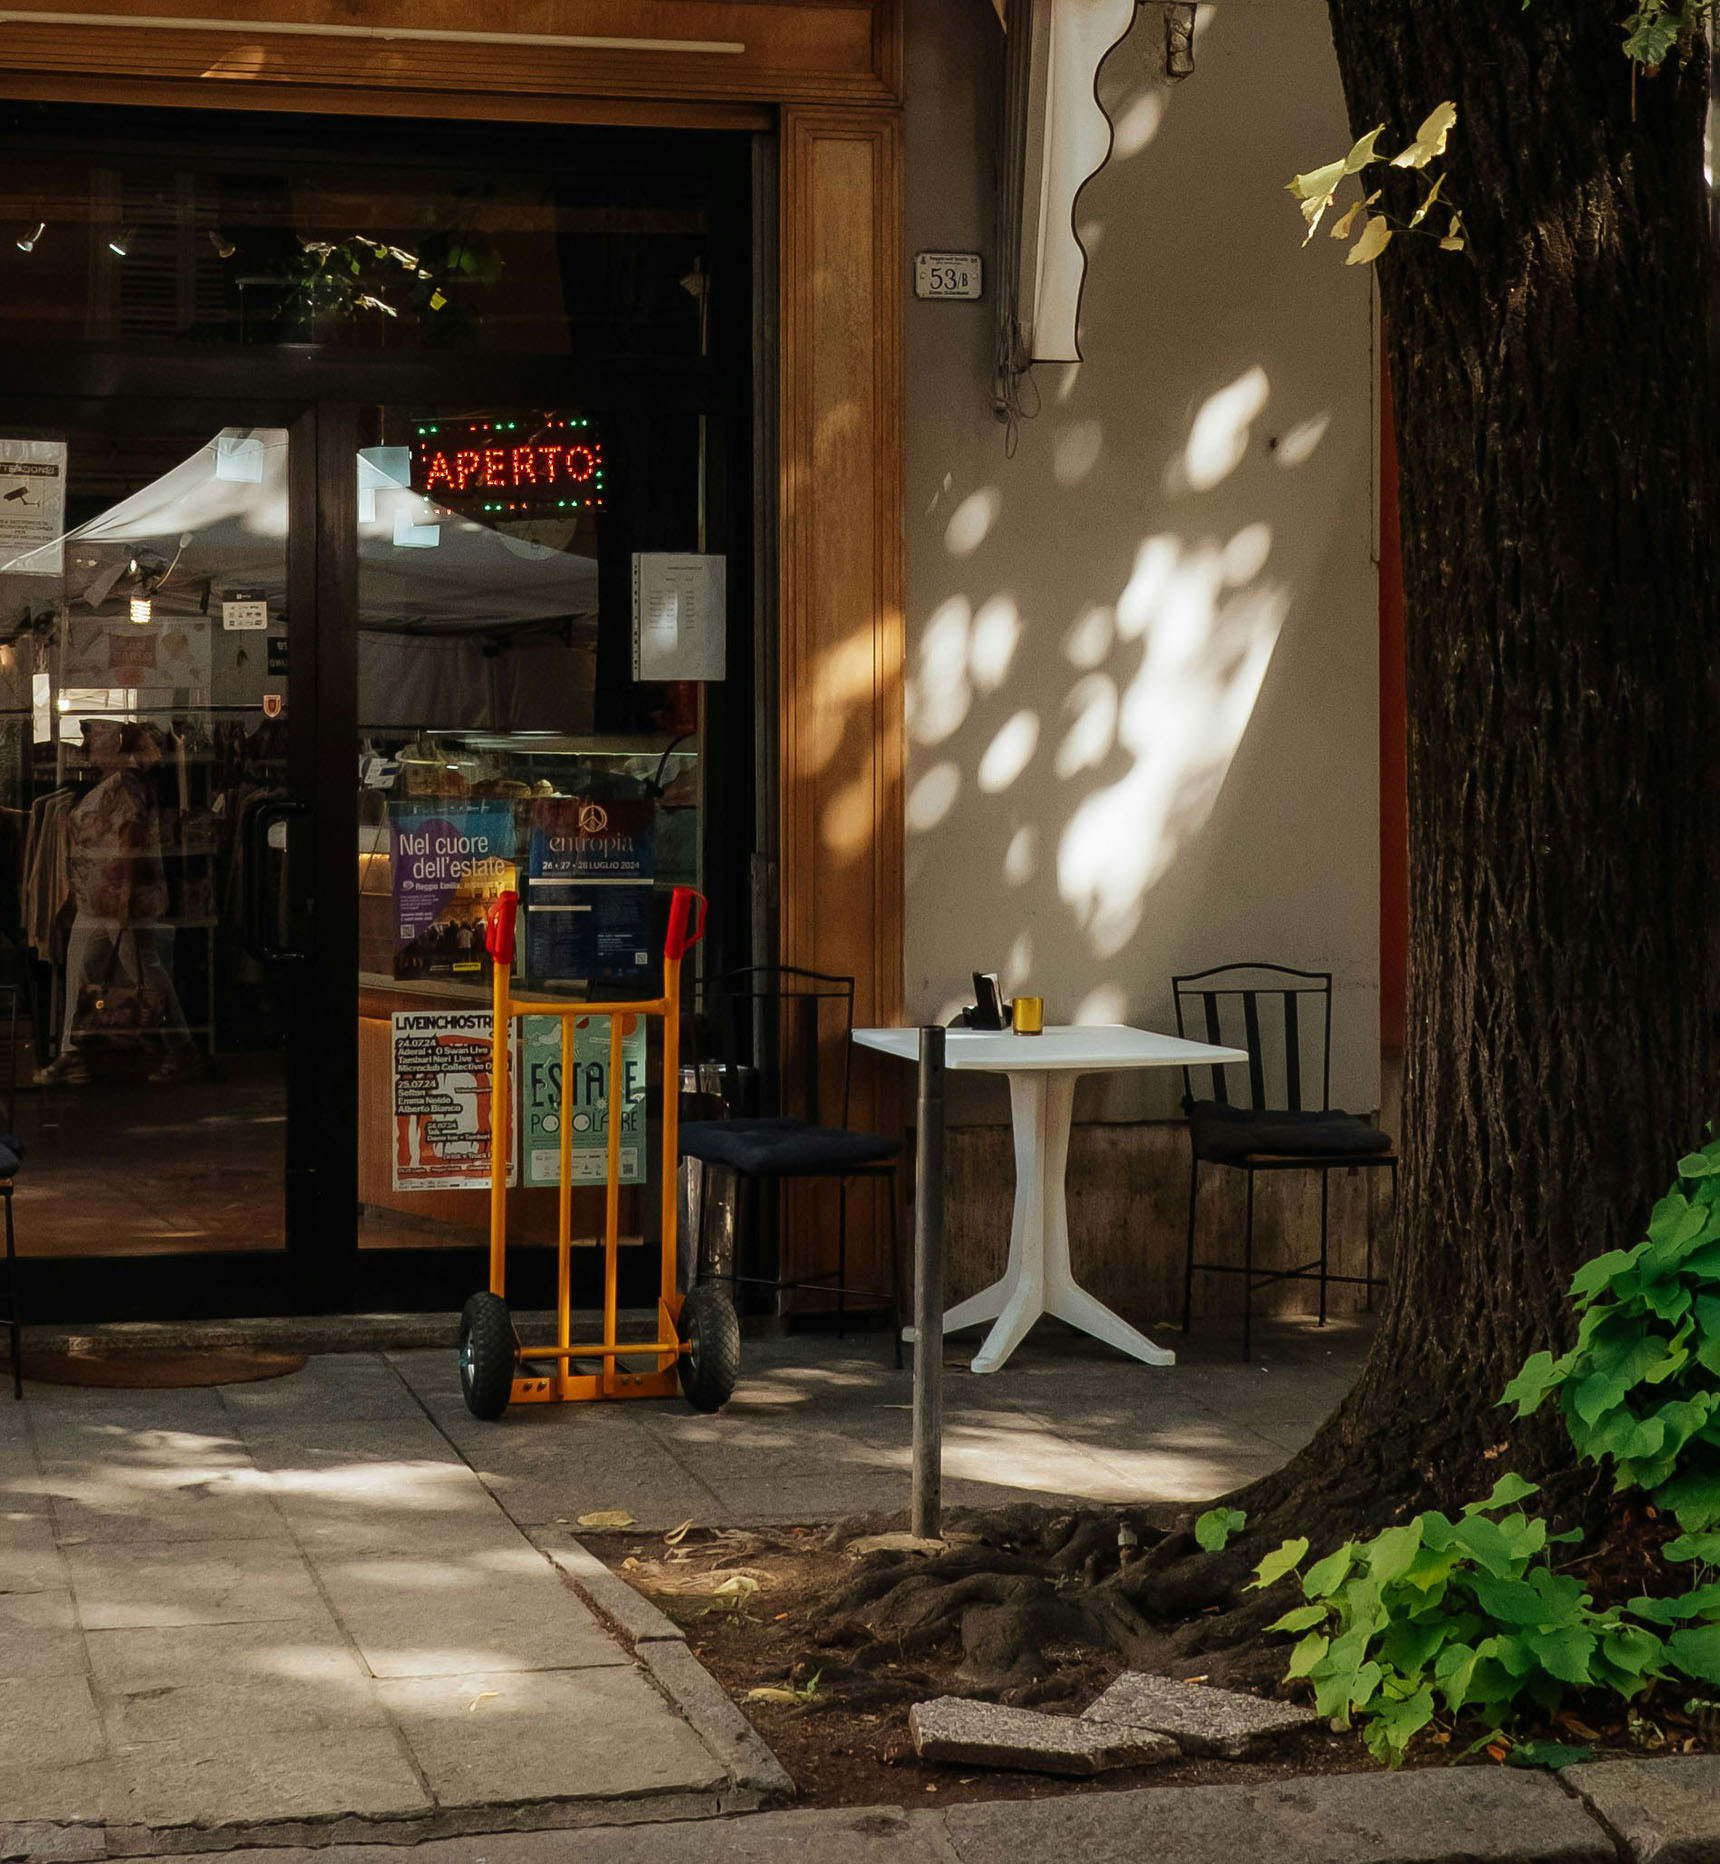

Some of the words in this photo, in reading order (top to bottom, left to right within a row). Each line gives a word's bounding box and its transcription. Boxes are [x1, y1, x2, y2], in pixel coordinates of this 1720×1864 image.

[427, 445, 594, 491] APERTO
[400, 832, 429, 855] Nel
[435, 835, 488, 855] cuore
[549, 833, 634, 858] entropia
[413, 856, 505, 878] dell'estate
[542, 861, 552, 870] 26
[560, 861, 571, 870] 27
[589, 861, 620, 870] LUGLIO
[621, 861, 640, 870] 2024
[470, 1045, 489, 1054] Live
[454, 1054, 473, 1063] Live
[441, 1062, 484, 1072] Collective
[531, 1061, 639, 1107] ESTAE
[398, 1104, 430, 1113] Alberto
[430, 1104, 461, 1112] Bianco
